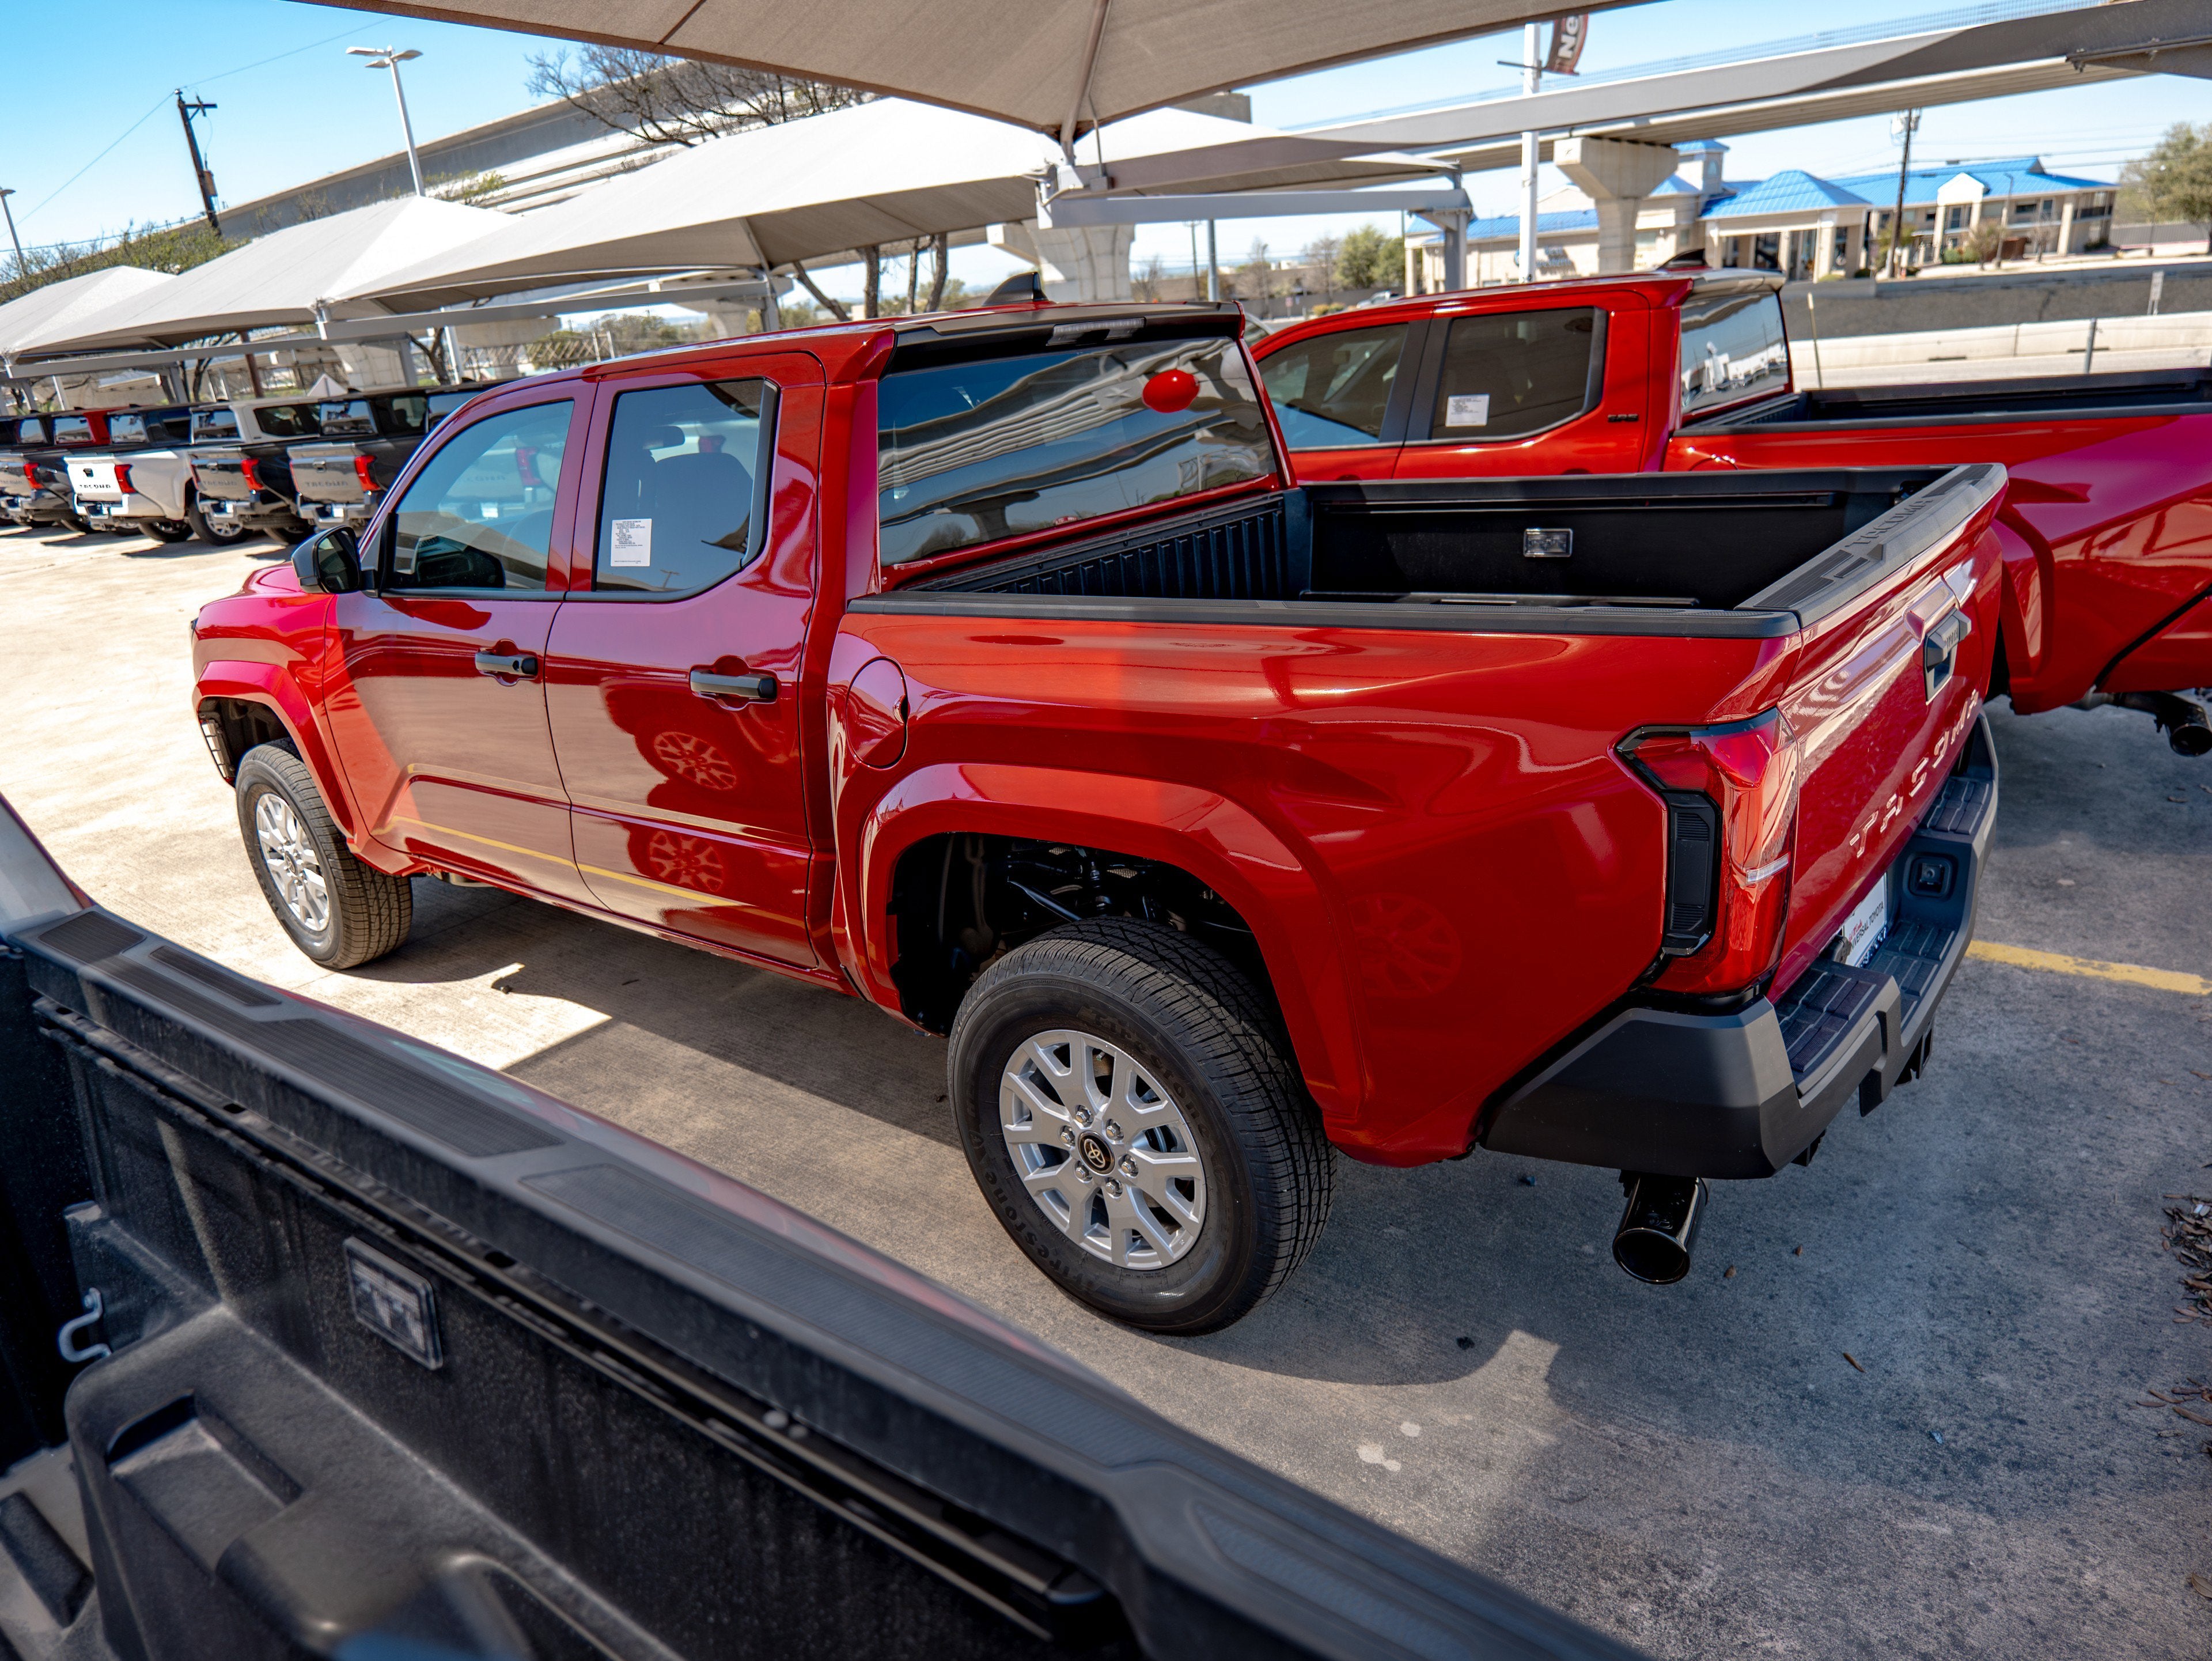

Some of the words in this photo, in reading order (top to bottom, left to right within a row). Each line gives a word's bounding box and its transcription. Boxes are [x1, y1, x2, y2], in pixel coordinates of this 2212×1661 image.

[1844, 500, 1933, 547] TACOMA
[1849, 688, 1978, 858] TACOMA
[983, 1170, 1092, 1292] Firestone
